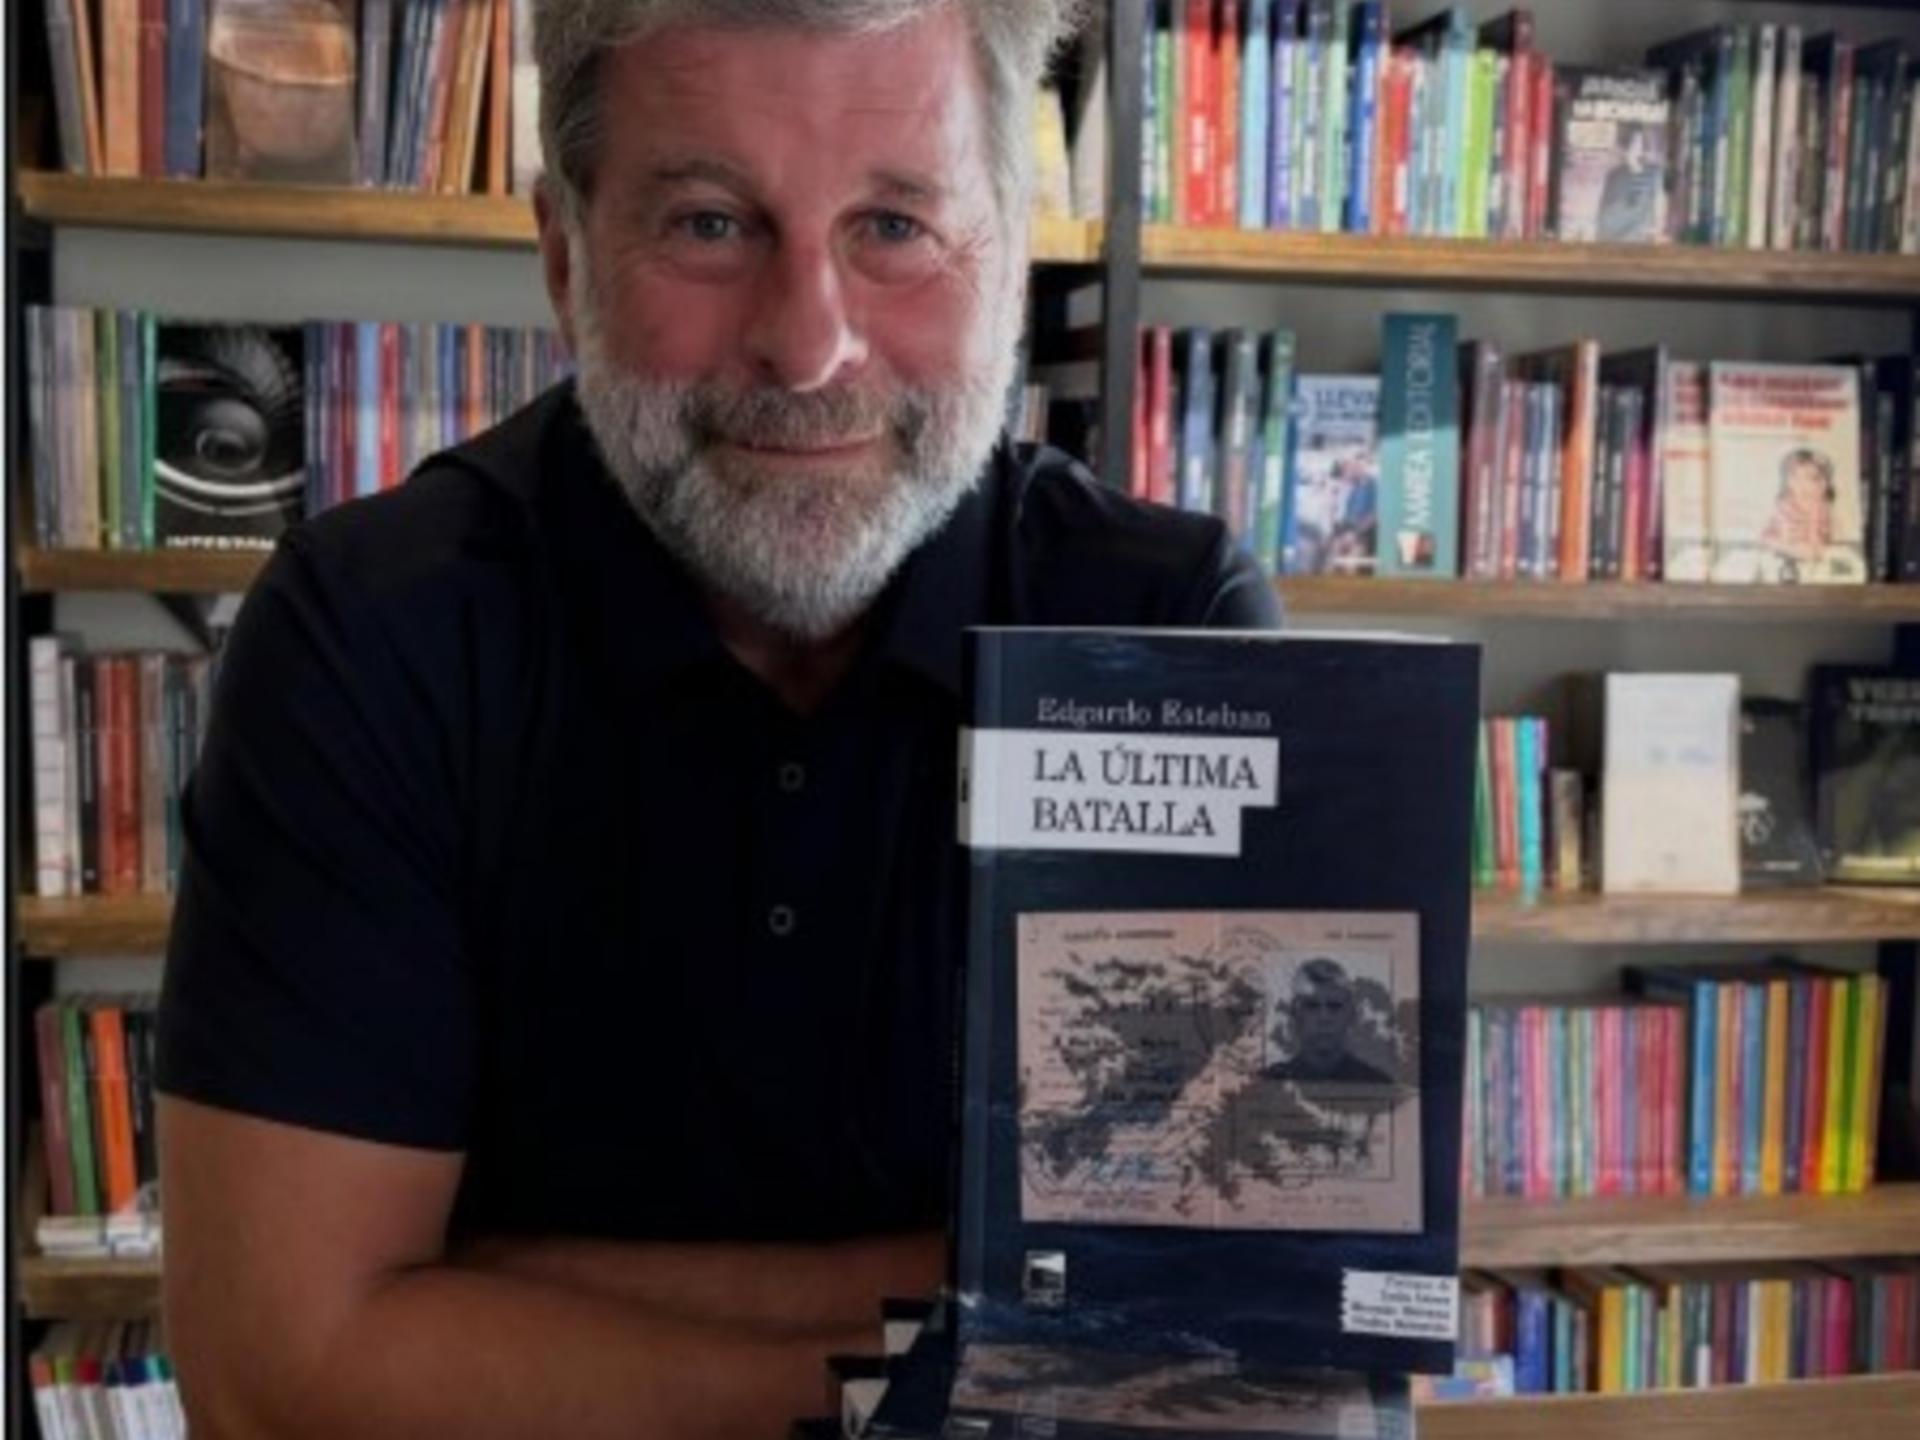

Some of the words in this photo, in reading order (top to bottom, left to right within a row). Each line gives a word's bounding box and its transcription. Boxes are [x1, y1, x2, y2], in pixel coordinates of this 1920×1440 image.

[1405, 321, 1436, 442] EDITORIAL
[1037, 697, 1151, 728] Edgardo
[1161, 699, 1272, 730] Esteban
[1034, 750, 1086, 783] LA
[1099, 742, 1261, 790] ÚLTIMA
[1033, 796, 1217, 838] BATALLA
